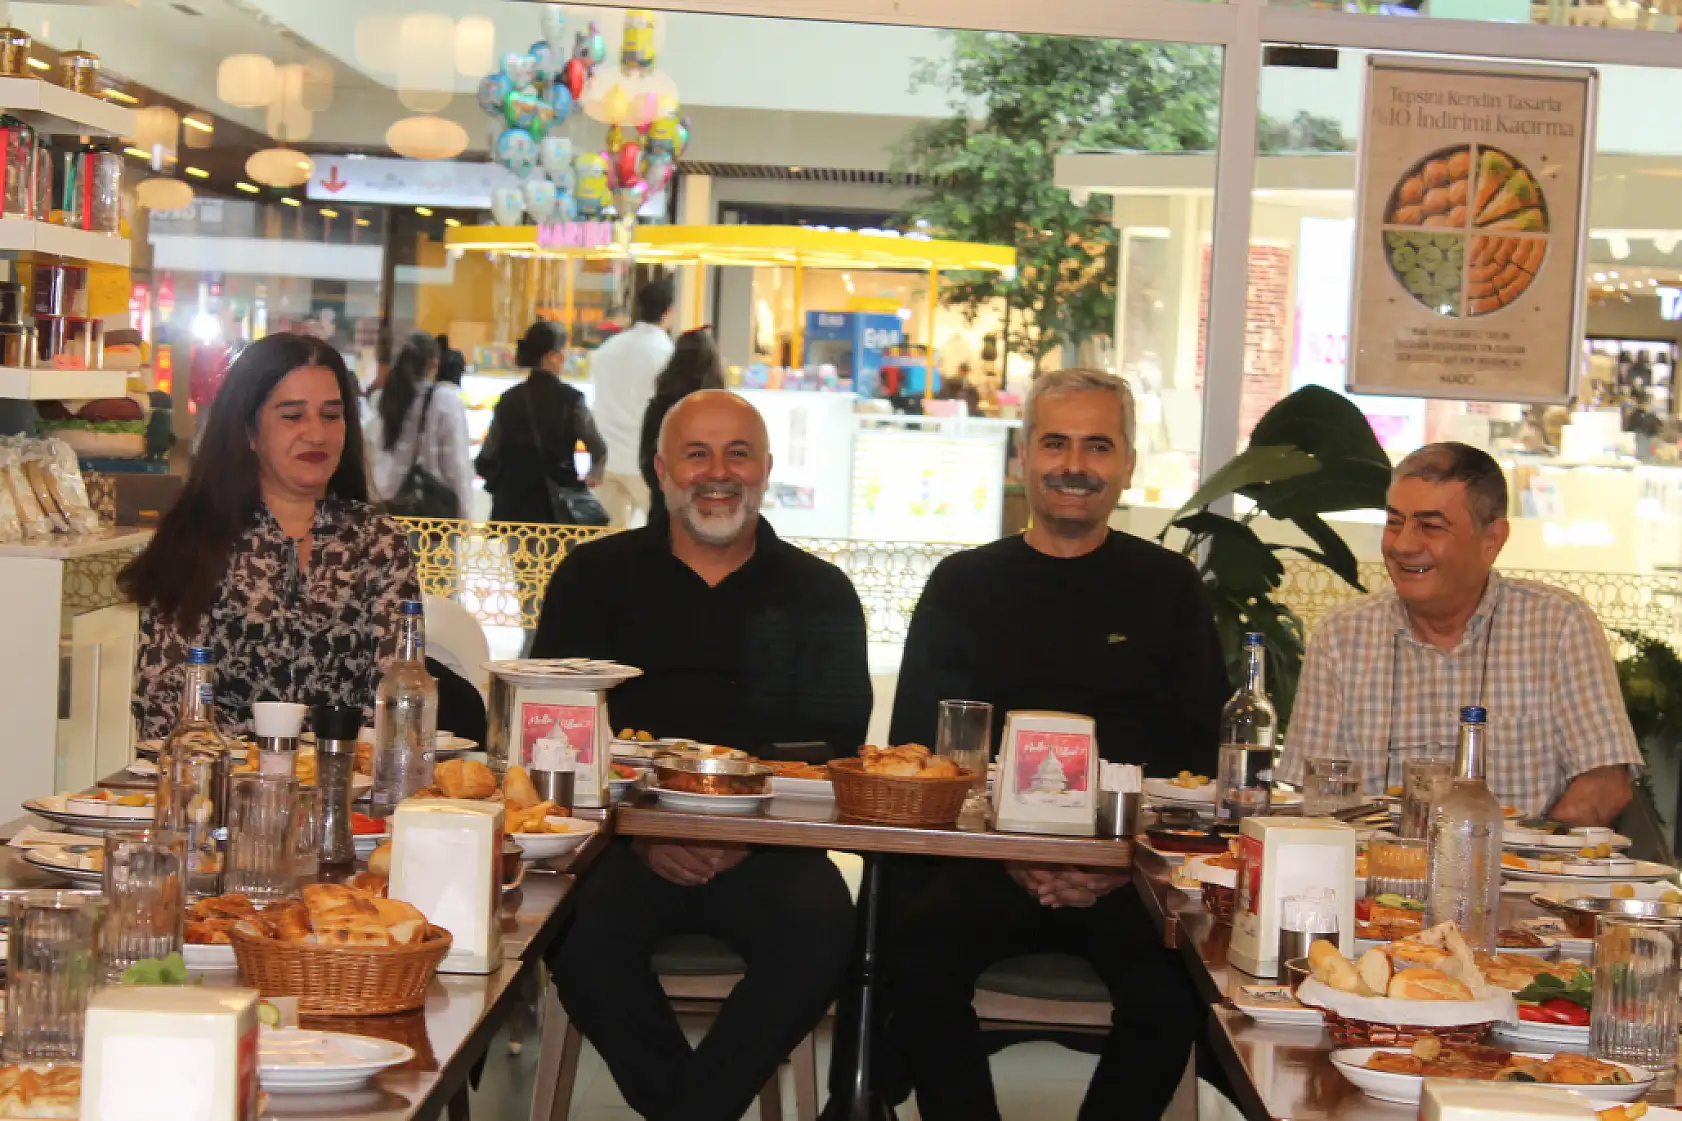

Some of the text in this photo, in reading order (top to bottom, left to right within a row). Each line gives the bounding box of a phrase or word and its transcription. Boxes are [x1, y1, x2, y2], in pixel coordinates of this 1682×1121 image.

[1389, 86, 1563, 113] Tepsini Kendin Tasarla
